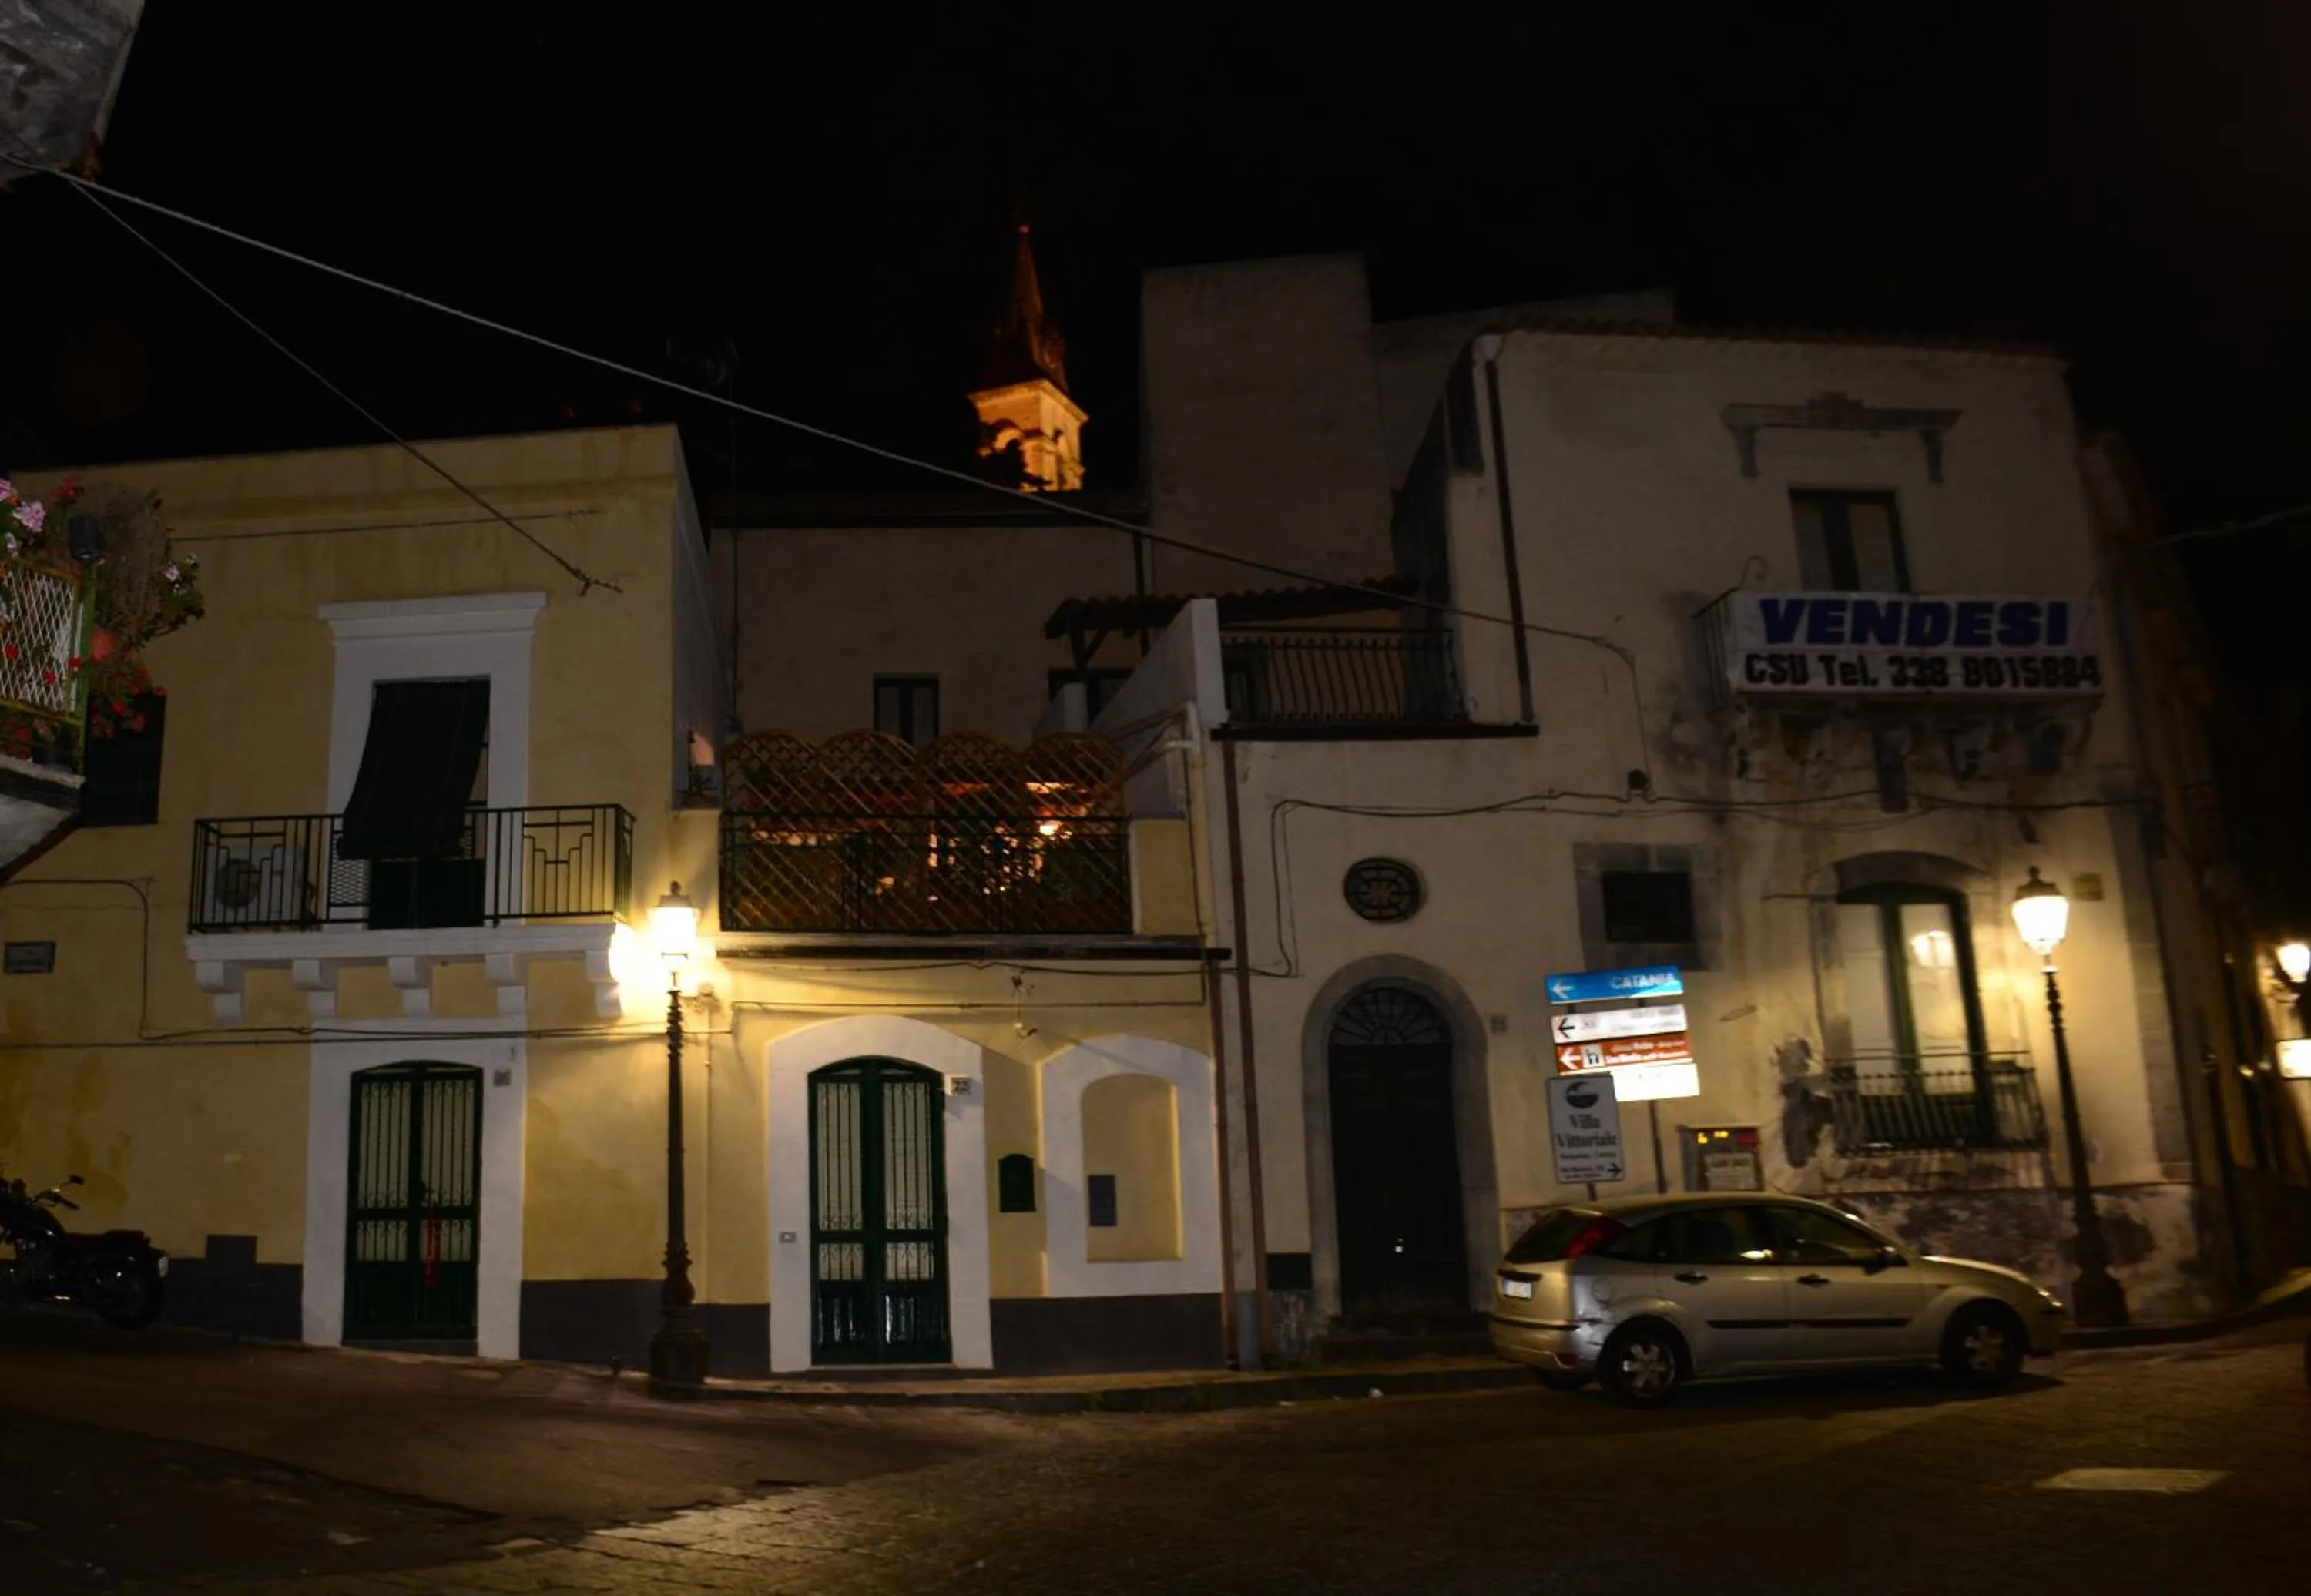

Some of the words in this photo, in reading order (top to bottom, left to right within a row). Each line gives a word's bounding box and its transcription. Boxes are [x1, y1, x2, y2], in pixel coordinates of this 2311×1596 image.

[1759, 598, 2069, 646] VENDESI
[1744, 653, 1809, 684] CSU
[1817, 653, 1879, 686] Tel.
[1887, 655, 1949, 687] 338
[1609, 972, 1677, 989] CATANIA
